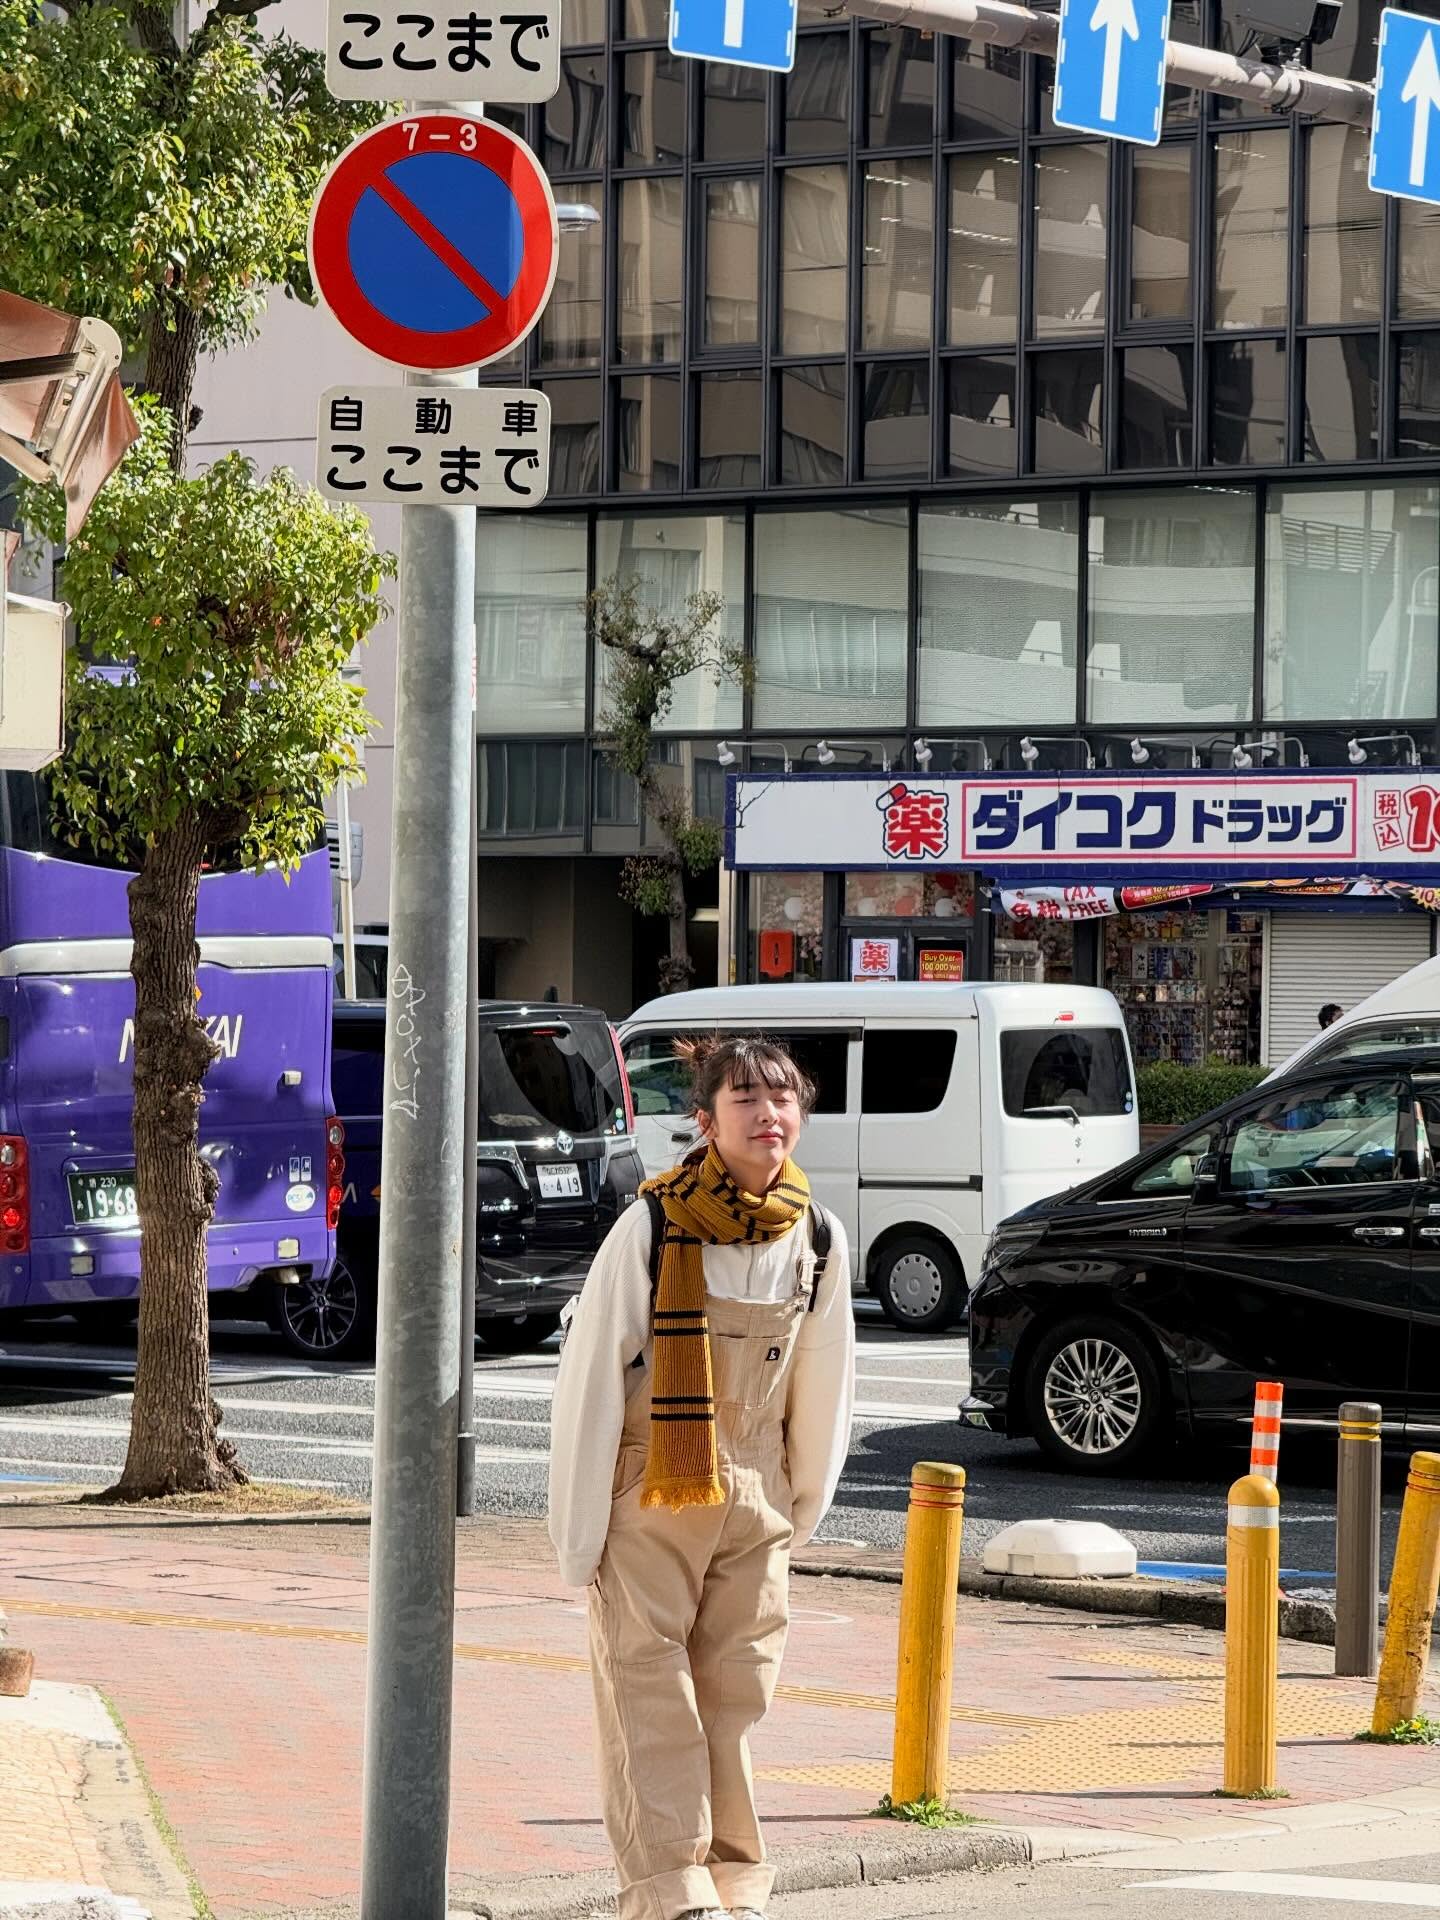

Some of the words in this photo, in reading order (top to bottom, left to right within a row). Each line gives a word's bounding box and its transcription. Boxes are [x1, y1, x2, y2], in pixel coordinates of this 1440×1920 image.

[339, 11, 550, 72] ここまで
[402, 122, 478, 152] 7-3
[326, 444, 540, 495] ここまで
[886, 790, 947, 857] 薬
[1067, 898, 1112, 919] FREE
[861, 941, 889, 972] 薬
[924, 953, 938, 962] Buy
[938, 953, 956, 961] Over
[949, 963, 961, 972] Yen
[100, 1176, 117, 1188] 230
